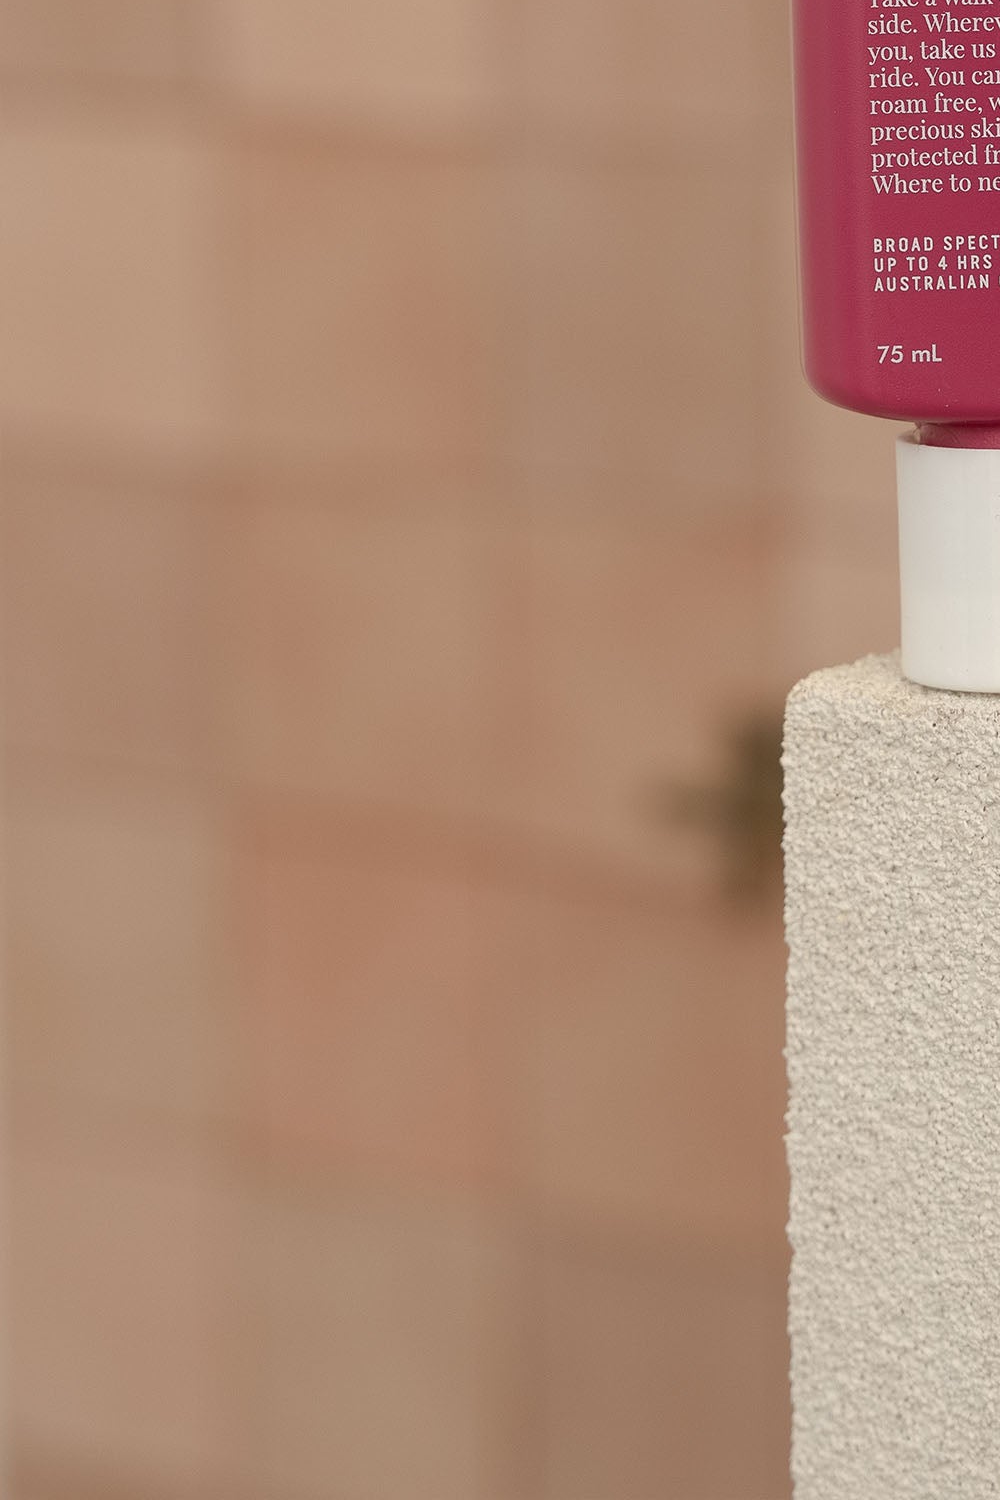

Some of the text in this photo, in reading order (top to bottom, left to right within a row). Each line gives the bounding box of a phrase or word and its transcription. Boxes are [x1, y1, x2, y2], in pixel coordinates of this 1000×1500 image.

[867, 12, 918, 35] side.
[867, 45, 914, 66] you,
[919, 37, 966, 60] take
[970, 43, 996, 59] us
[868, 66, 920, 88] ride.
[924, 66, 966, 87] You
[869, 98, 929, 115] roam
[933, 91, 983, 115] free,
[870, 118, 965, 146] precious
[870, 143, 979, 173] protected
[870, 172, 944, 195] Where
[948, 173, 972, 193] to
[873, 236, 934, 253] BROAD
[873, 257, 897, 273] UP
[905, 255, 929, 272] TO
[937, 255, 948, 271] 4
[957, 253, 993, 270] HRS
[874, 273, 990, 293] AUSTRALIAN
[876, 343, 943, 364] 75 mL
